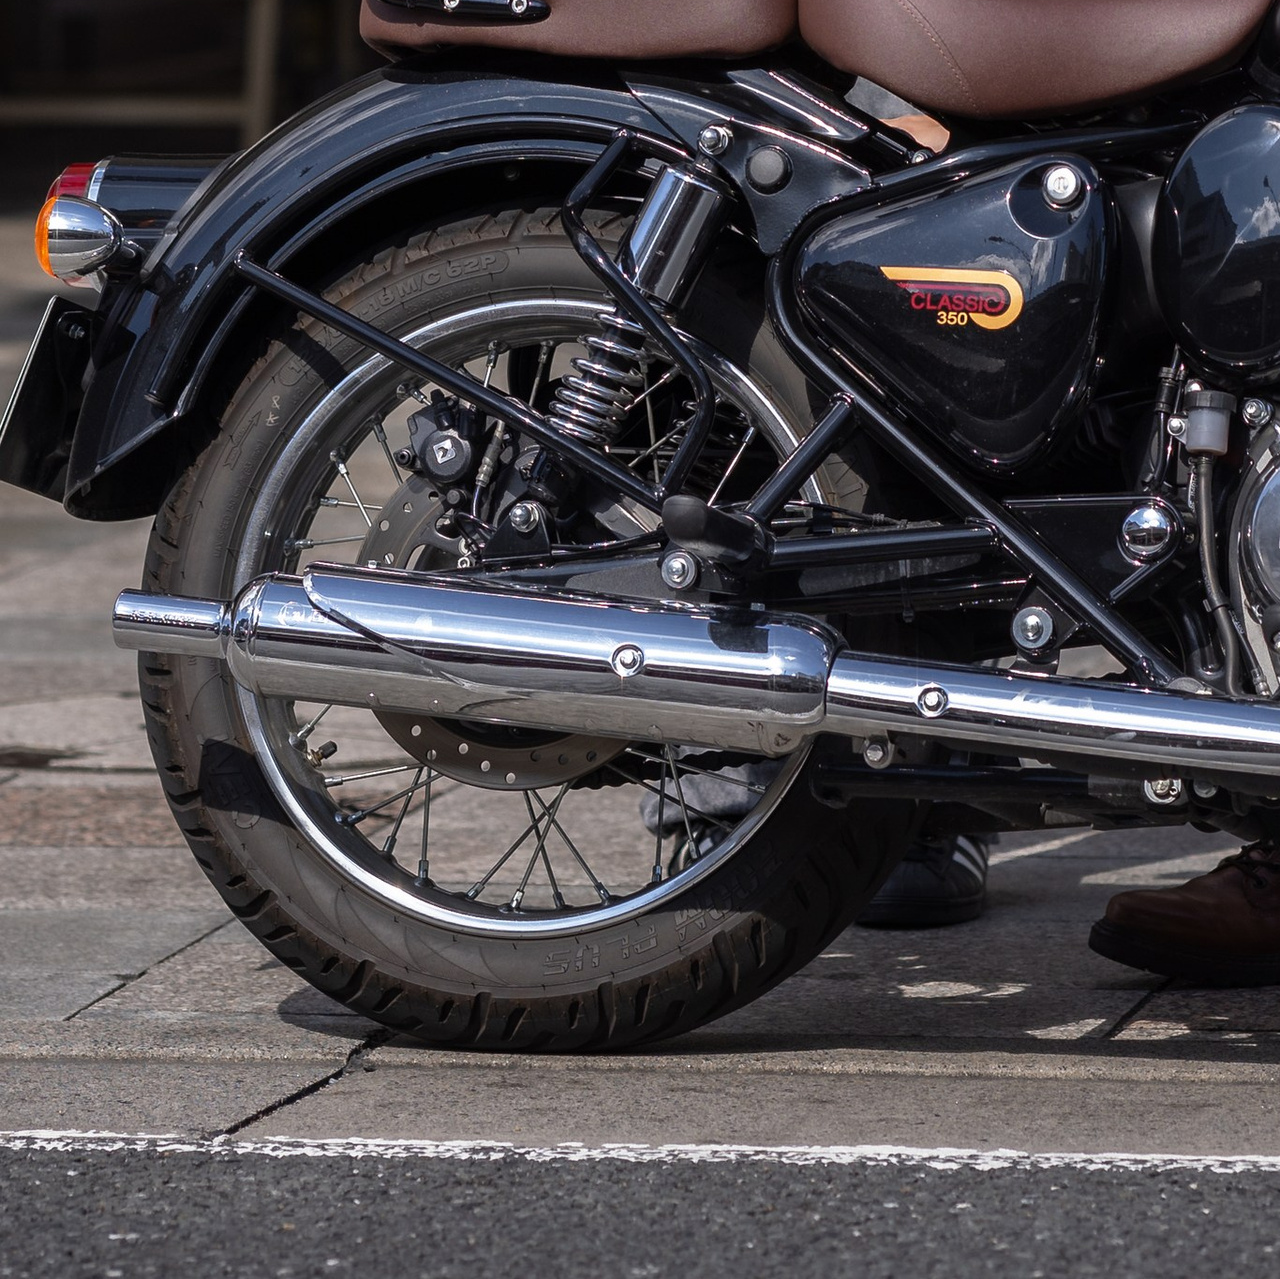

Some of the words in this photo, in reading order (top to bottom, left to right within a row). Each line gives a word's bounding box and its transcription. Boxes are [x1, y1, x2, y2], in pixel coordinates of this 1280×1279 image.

[446, 253, 497, 278] 62P
[911, 292, 1005, 312] CLASSIC
[936, 311, 968, 326] 350
